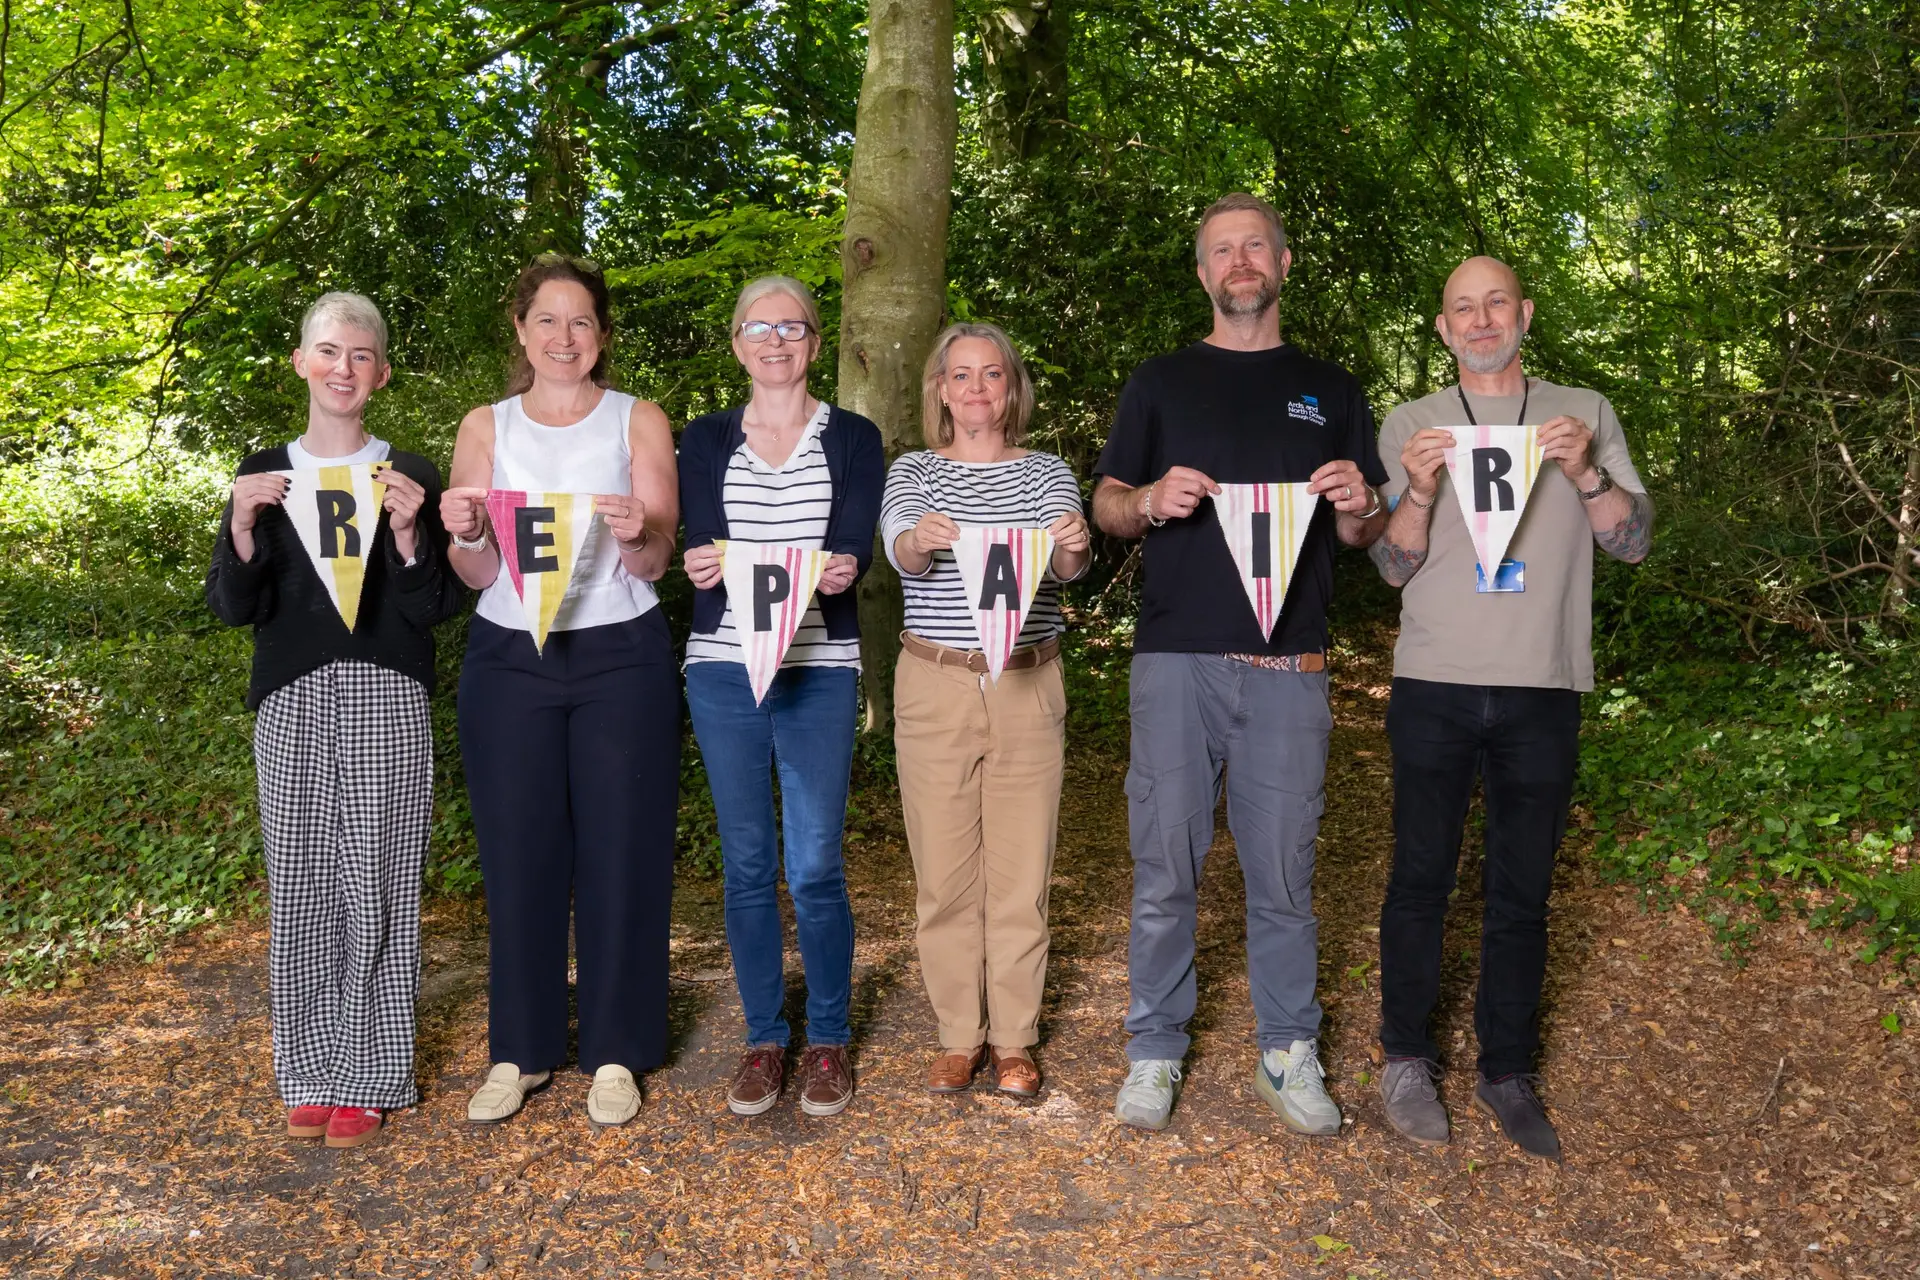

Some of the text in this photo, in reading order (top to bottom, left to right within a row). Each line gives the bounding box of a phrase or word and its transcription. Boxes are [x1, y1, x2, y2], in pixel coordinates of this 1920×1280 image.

[1288, 401, 1318, 413] Ards and
[1288, 406, 1326, 422] North Down
[1472, 447, 1514, 512] R
[316, 490, 361, 558] R
[515, 507, 559, 573] E
[1251, 512, 1271, 578] I
[753, 564, 790, 631] P
[978, 543, 1021, 610] A
